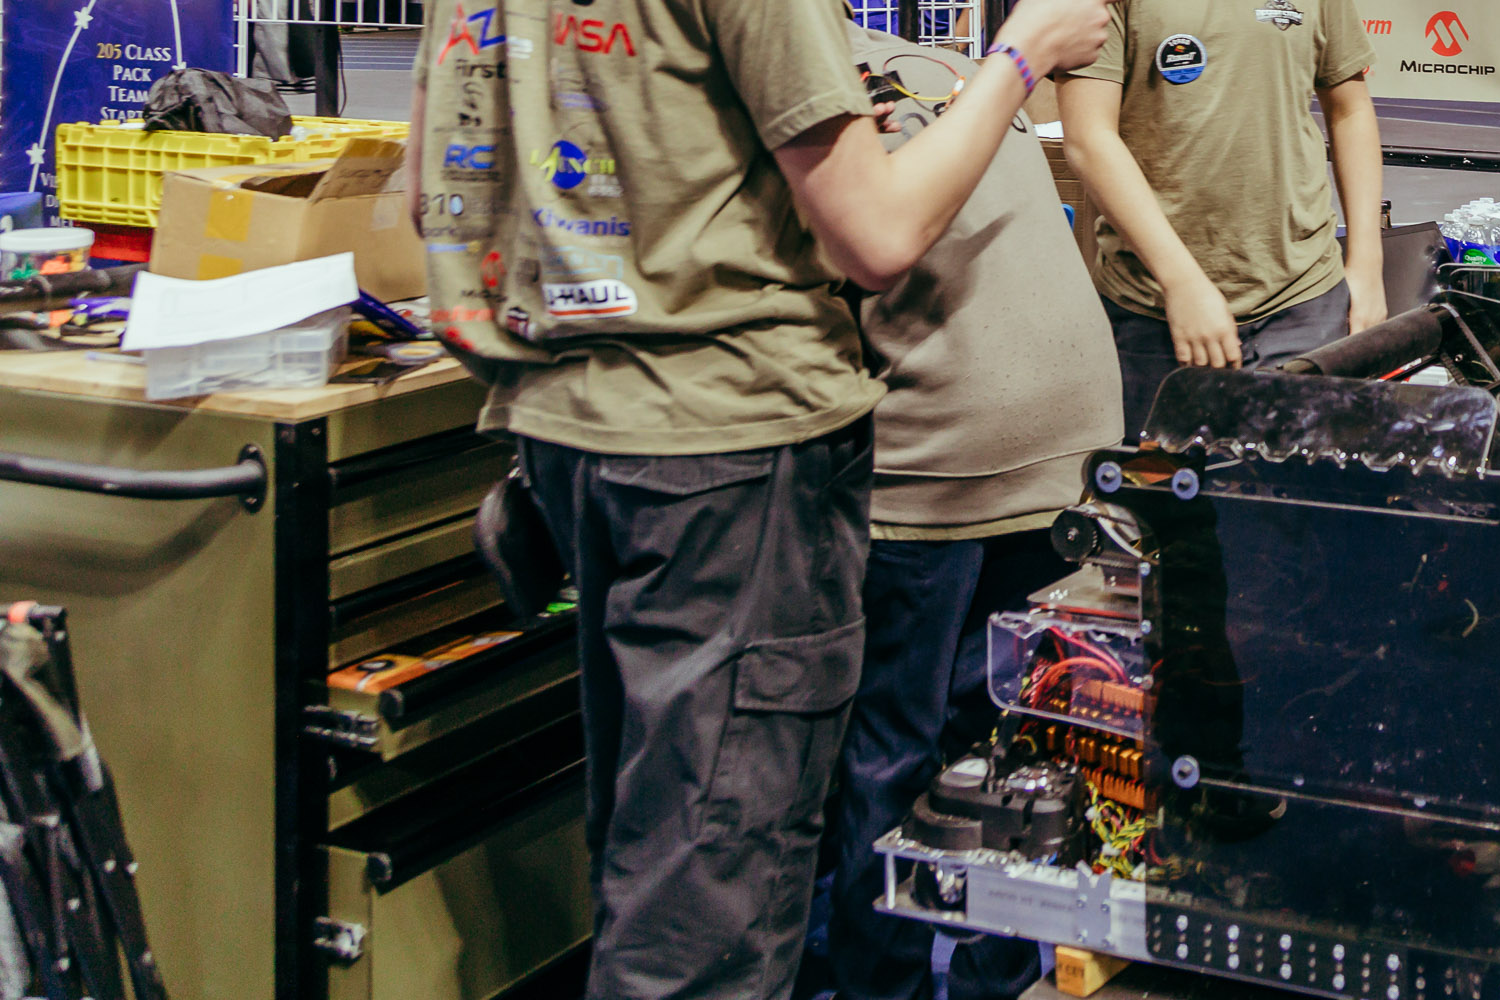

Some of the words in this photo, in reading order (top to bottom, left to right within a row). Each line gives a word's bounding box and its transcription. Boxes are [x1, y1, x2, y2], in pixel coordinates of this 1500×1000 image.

[96, 43, 122, 59] 205
[125, 44, 171, 62] CLASS
[113, 65, 152, 82] PACK
[1400, 60, 1496, 76] MICROCHIP
[108, 86, 149, 102] TEAM
[443, 143, 495, 169] RC
